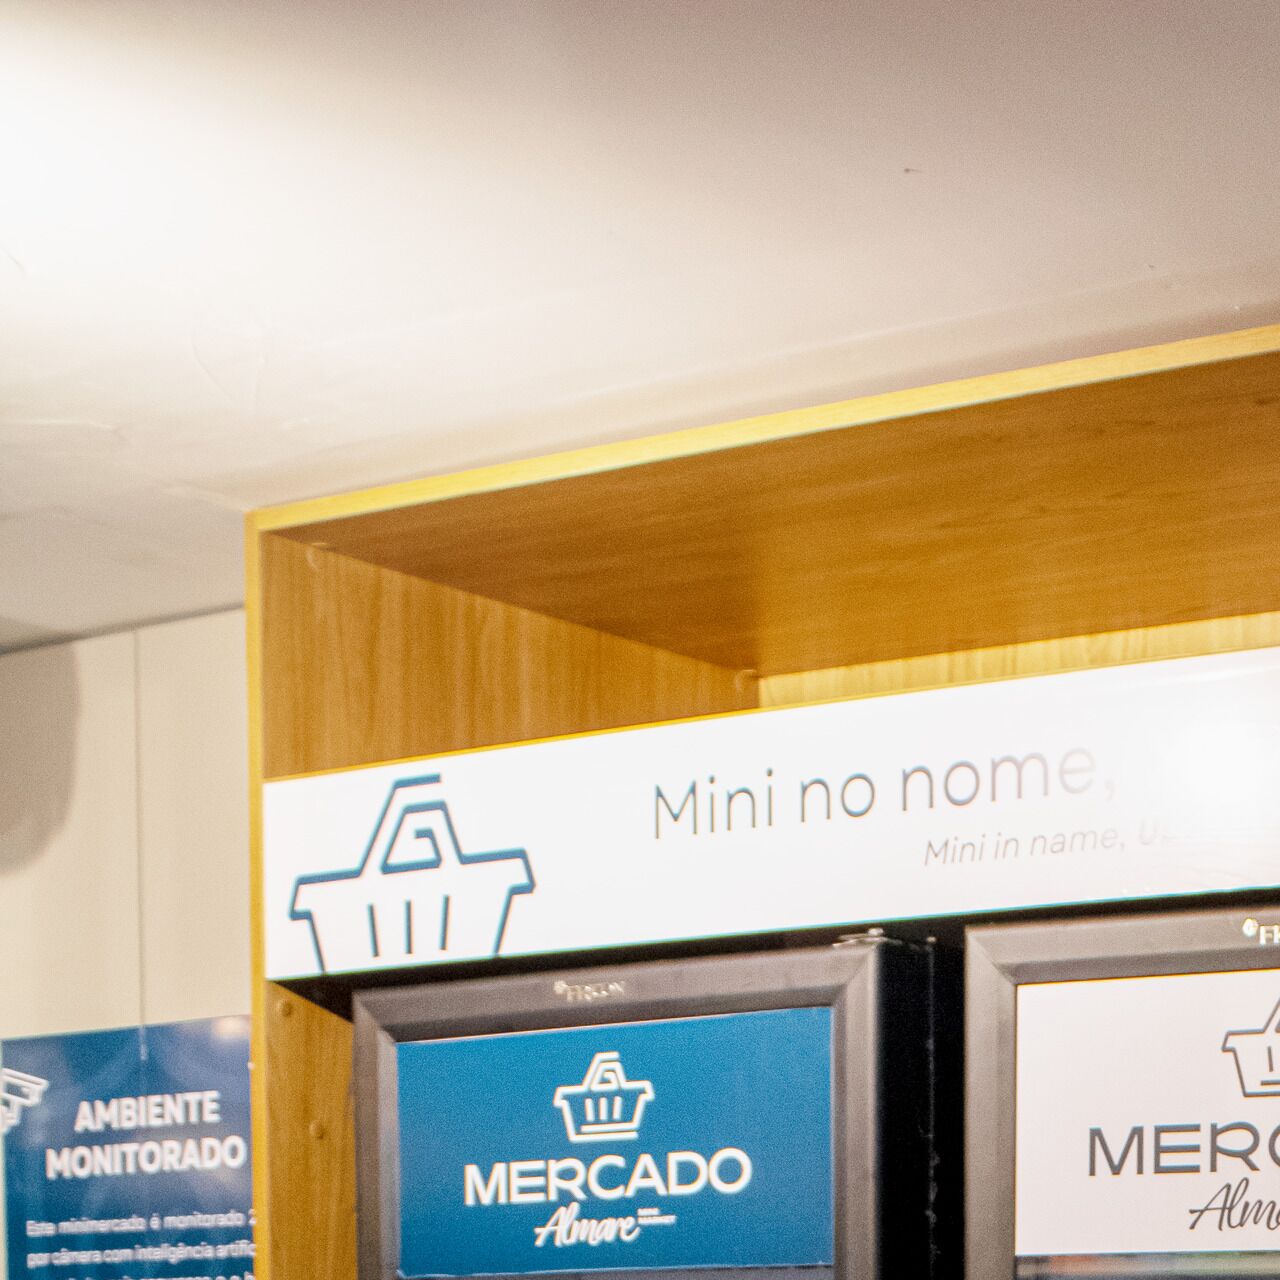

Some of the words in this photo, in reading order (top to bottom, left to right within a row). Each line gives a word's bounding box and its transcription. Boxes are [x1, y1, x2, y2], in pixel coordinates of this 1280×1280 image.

[653, 767, 775, 841] Mini
[799, 771, 877, 823] no
[924, 833, 987, 867] Mini
[993, 831, 1020, 861] in
[1029, 827, 1126, 858] name,
[74, 1090, 222, 1134] AMBIENTE
[46, 1136, 247, 1180] MONITORADO
[464, 1146, 754, 1207] MERCADO
[534, 1202, 641, 1248] Almare
